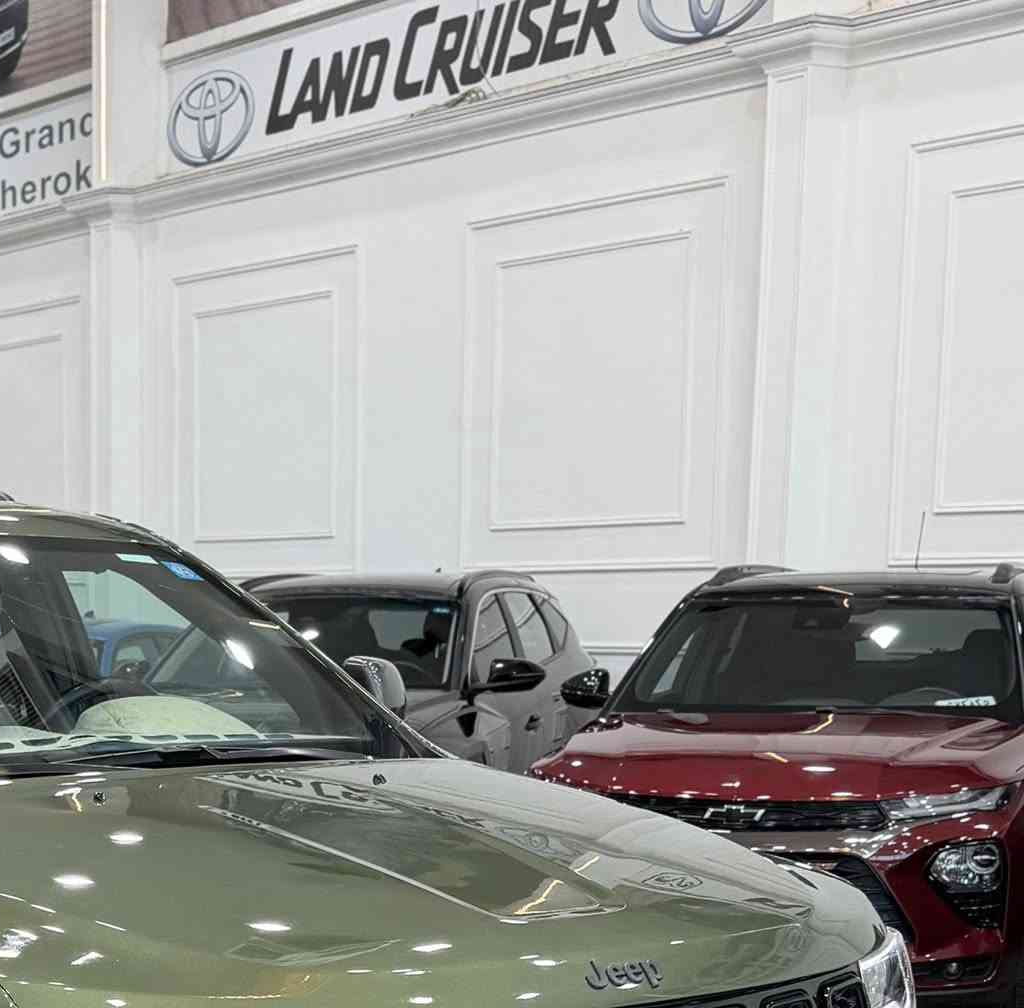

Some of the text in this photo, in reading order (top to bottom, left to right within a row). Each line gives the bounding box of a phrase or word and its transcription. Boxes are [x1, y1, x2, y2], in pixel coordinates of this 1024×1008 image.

[265, 0, 616, 135] LAND CRUISER
[585, 960, 663, 990] Jeep
